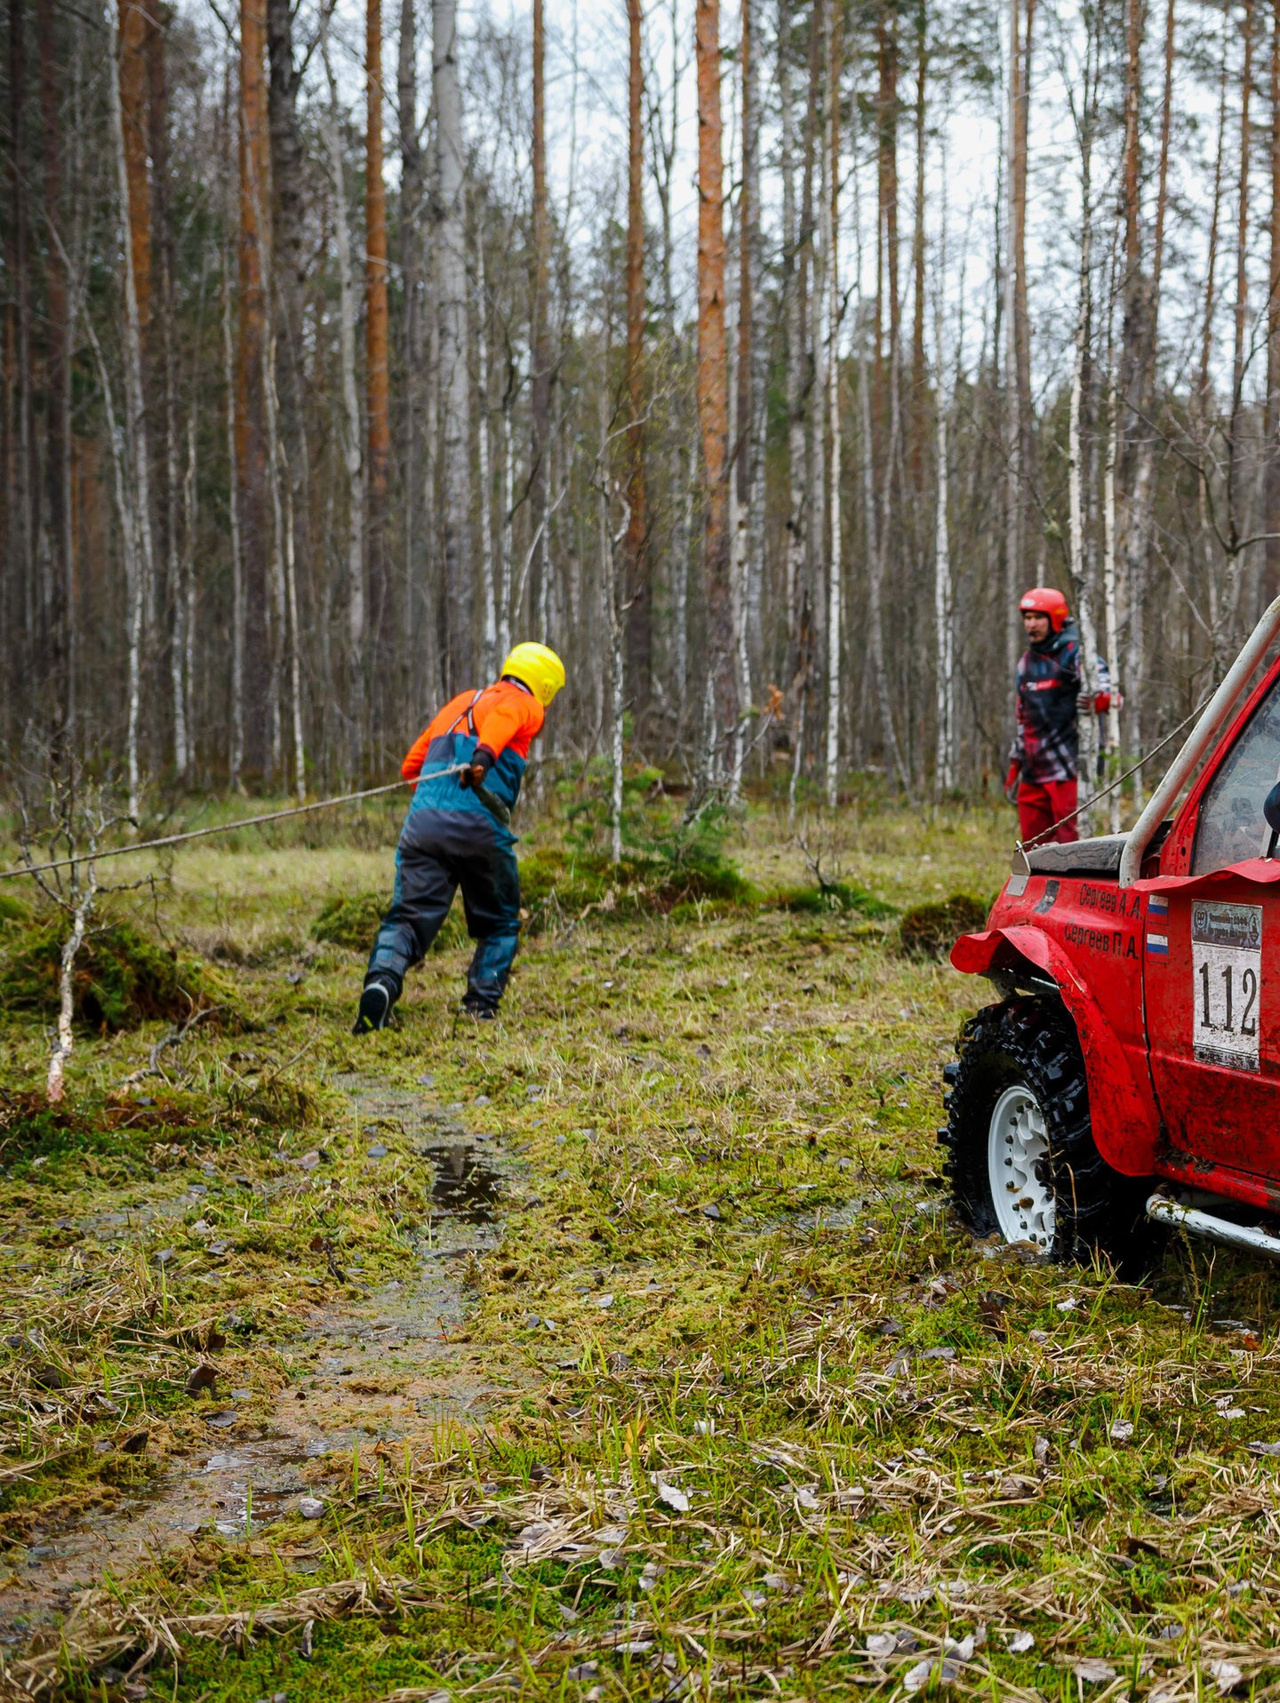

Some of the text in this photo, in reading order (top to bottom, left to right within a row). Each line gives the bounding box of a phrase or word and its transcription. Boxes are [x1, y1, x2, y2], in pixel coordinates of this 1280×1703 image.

[1079, 883, 1117, 912] Сергеев
[1064, 919, 1110, 952] Сергеев
[1199, 961, 1257, 1037] 112
